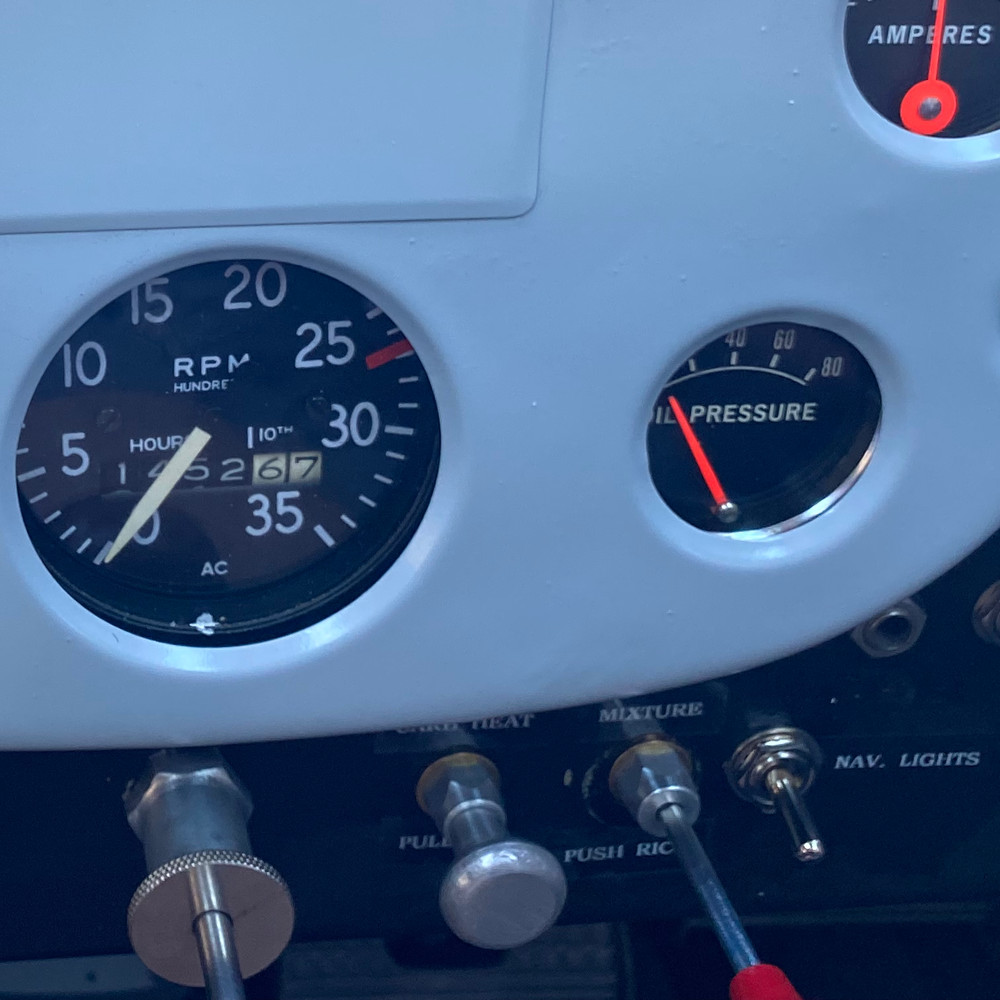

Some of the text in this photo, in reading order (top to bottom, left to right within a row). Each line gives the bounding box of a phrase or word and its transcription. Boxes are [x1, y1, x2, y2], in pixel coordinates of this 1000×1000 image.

[223, 261, 288, 311] 20
[130, 277, 174, 326] 15
[294, 320, 355, 369] 25
[725, 327, 747, 347] 40
[773, 329, 796, 350] 60
[63, 341, 107, 388] 10
[821, 356, 843, 377] 80
[173, 378, 234, 393] HUNDRE
[655, 402, 818, 424] IL PRESSURE
[320, 401, 380, 449] 30
[62, 432, 89, 477] 5
[129, 435, 184, 453] HOUR
[245, 491, 304, 537] 35
[200, 560, 229, 577] AC
[598, 701, 704, 724] MIXTURE
[833, 751, 981, 770] NAV. LIGHTS
[564, 840, 674, 863] PUSH RIC
